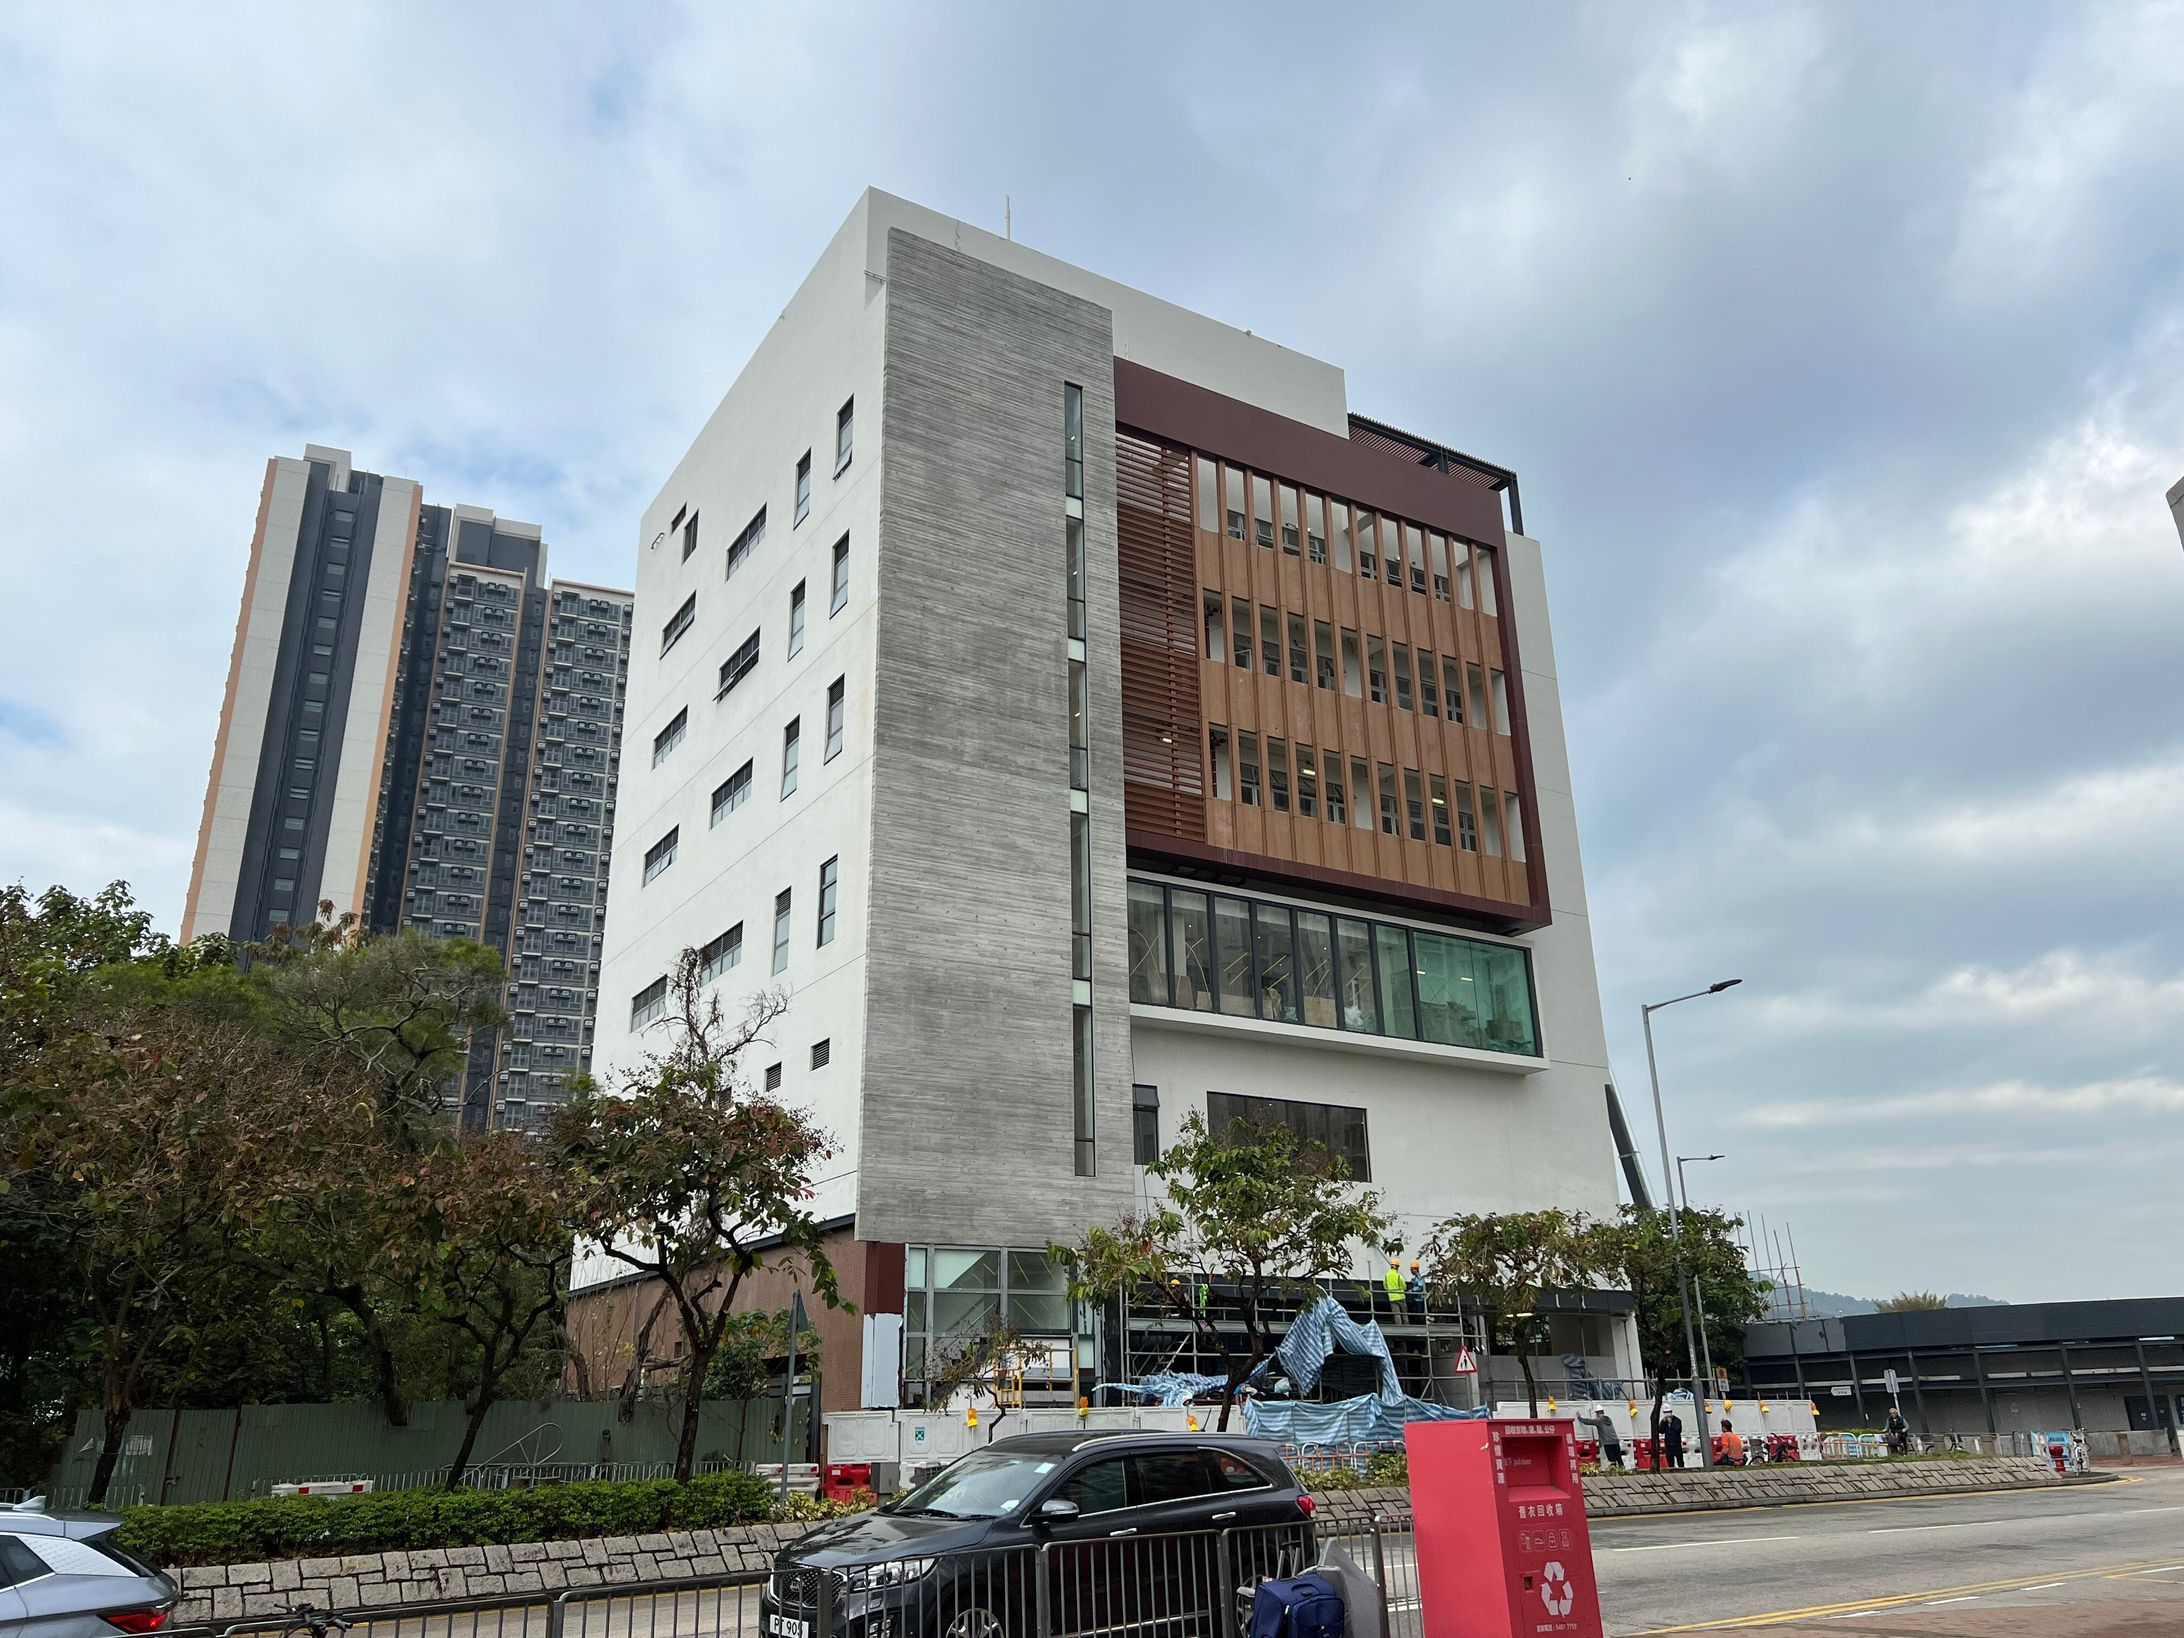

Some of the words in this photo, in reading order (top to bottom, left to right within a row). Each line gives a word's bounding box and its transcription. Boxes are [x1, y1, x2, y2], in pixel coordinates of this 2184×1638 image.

[1518, 1503, 1563, 1519] 舊衣回收箱
